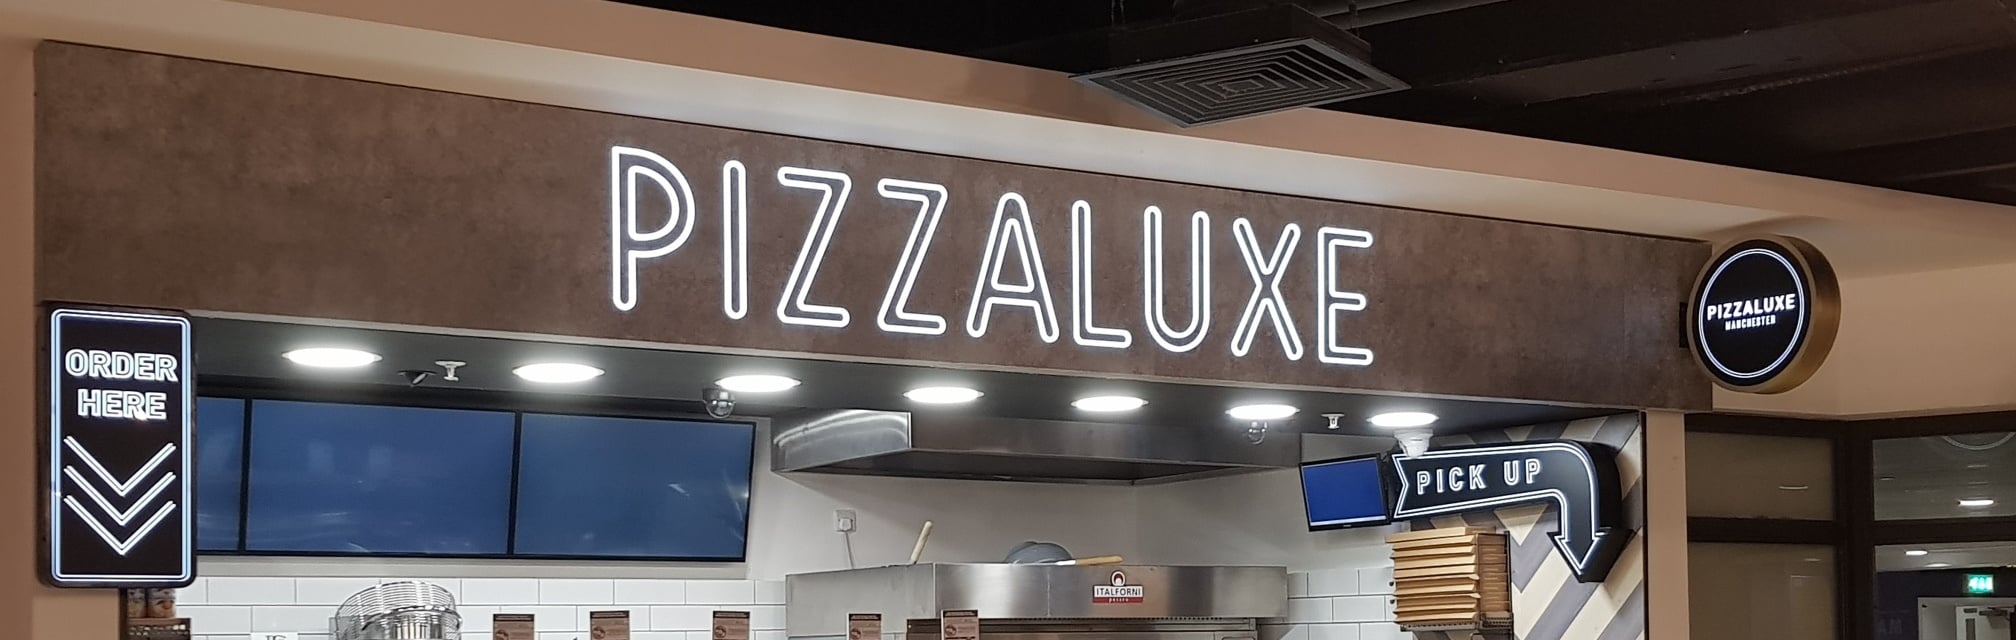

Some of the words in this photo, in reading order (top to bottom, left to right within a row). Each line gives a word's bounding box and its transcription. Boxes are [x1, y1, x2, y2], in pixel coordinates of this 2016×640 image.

[611, 145, 1374, 366] PIZZALUXE
[1707, 293, 1796, 321] PIZZALUXE
[65, 348, 178, 382] ORDER
[77, 388, 168, 420] HERE
[1416, 463, 1487, 495] PICK
[1503, 458, 1543, 486] UP
[1096, 588, 1141, 596] ITALFORNI
